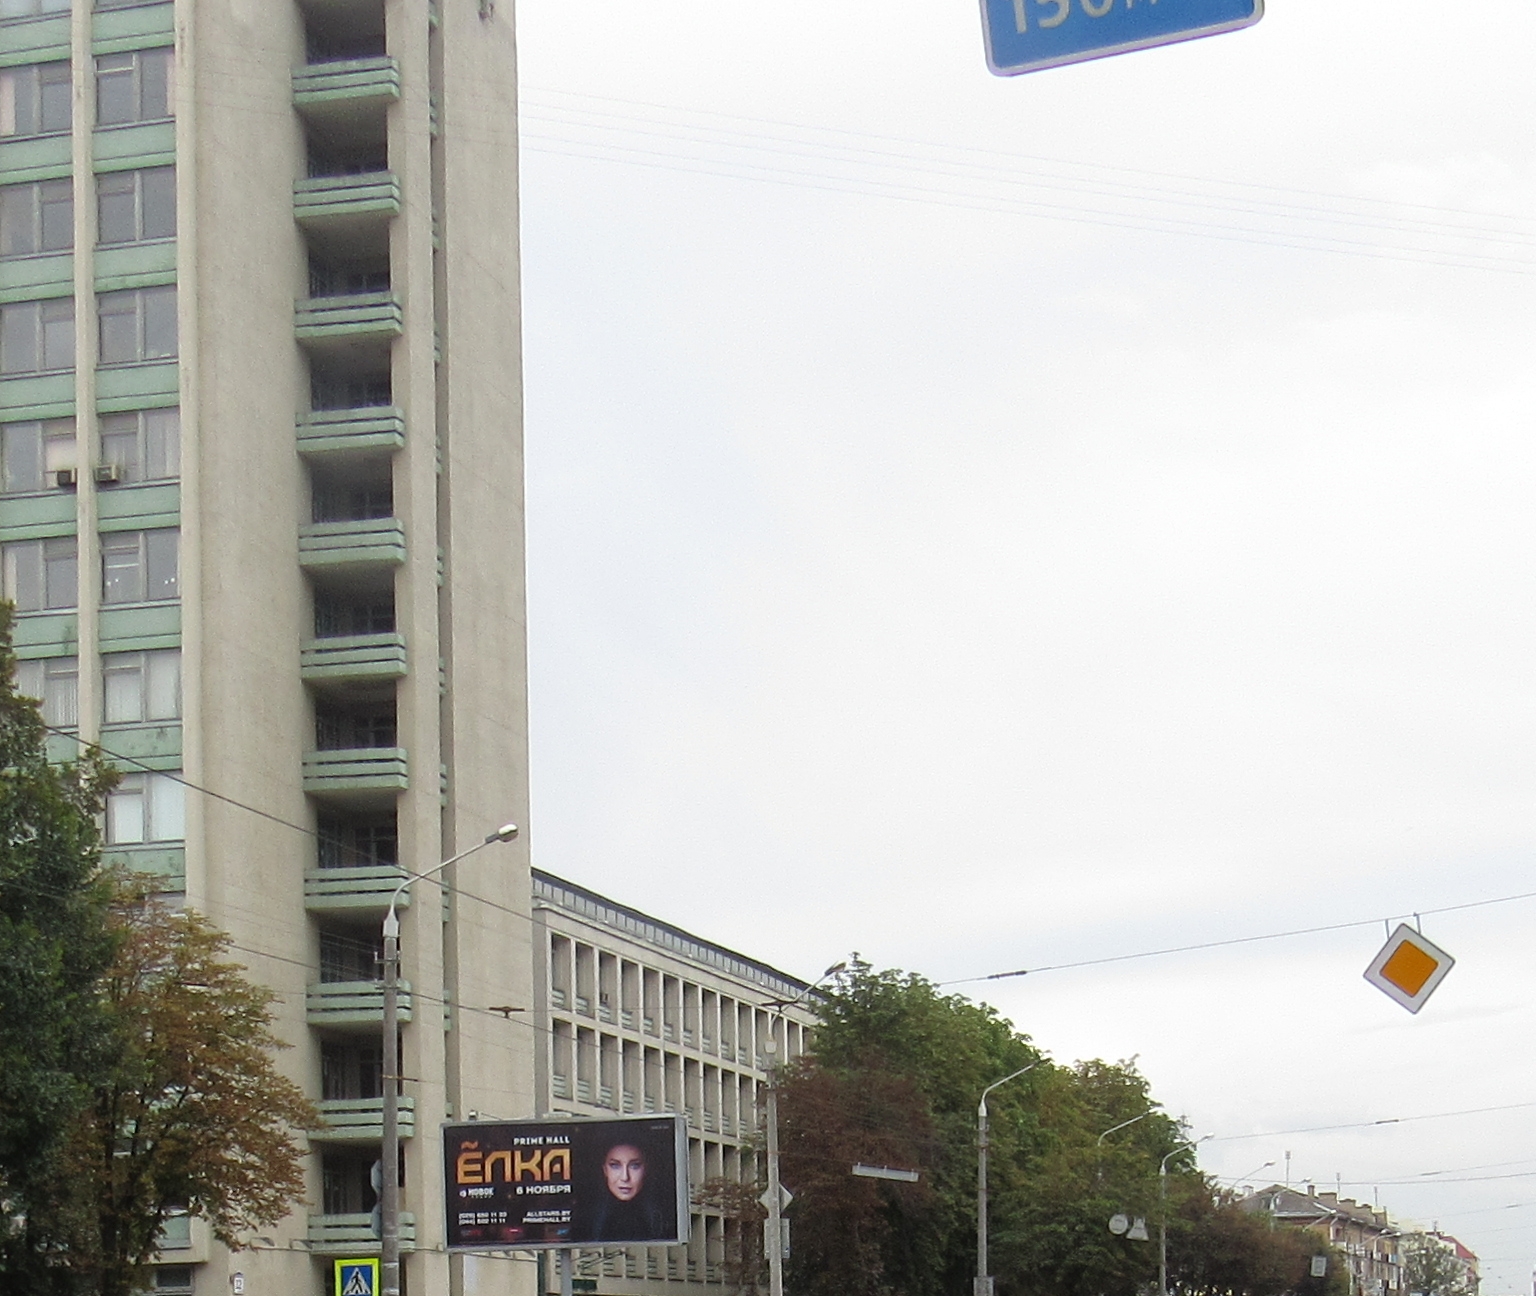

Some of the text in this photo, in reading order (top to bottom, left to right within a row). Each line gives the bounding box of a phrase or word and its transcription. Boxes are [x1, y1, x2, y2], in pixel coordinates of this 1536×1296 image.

[514, 1135, 570, 1146] PRIME HALL
[516, 1184, 572, 1195] 6 НОЯБРЯ
